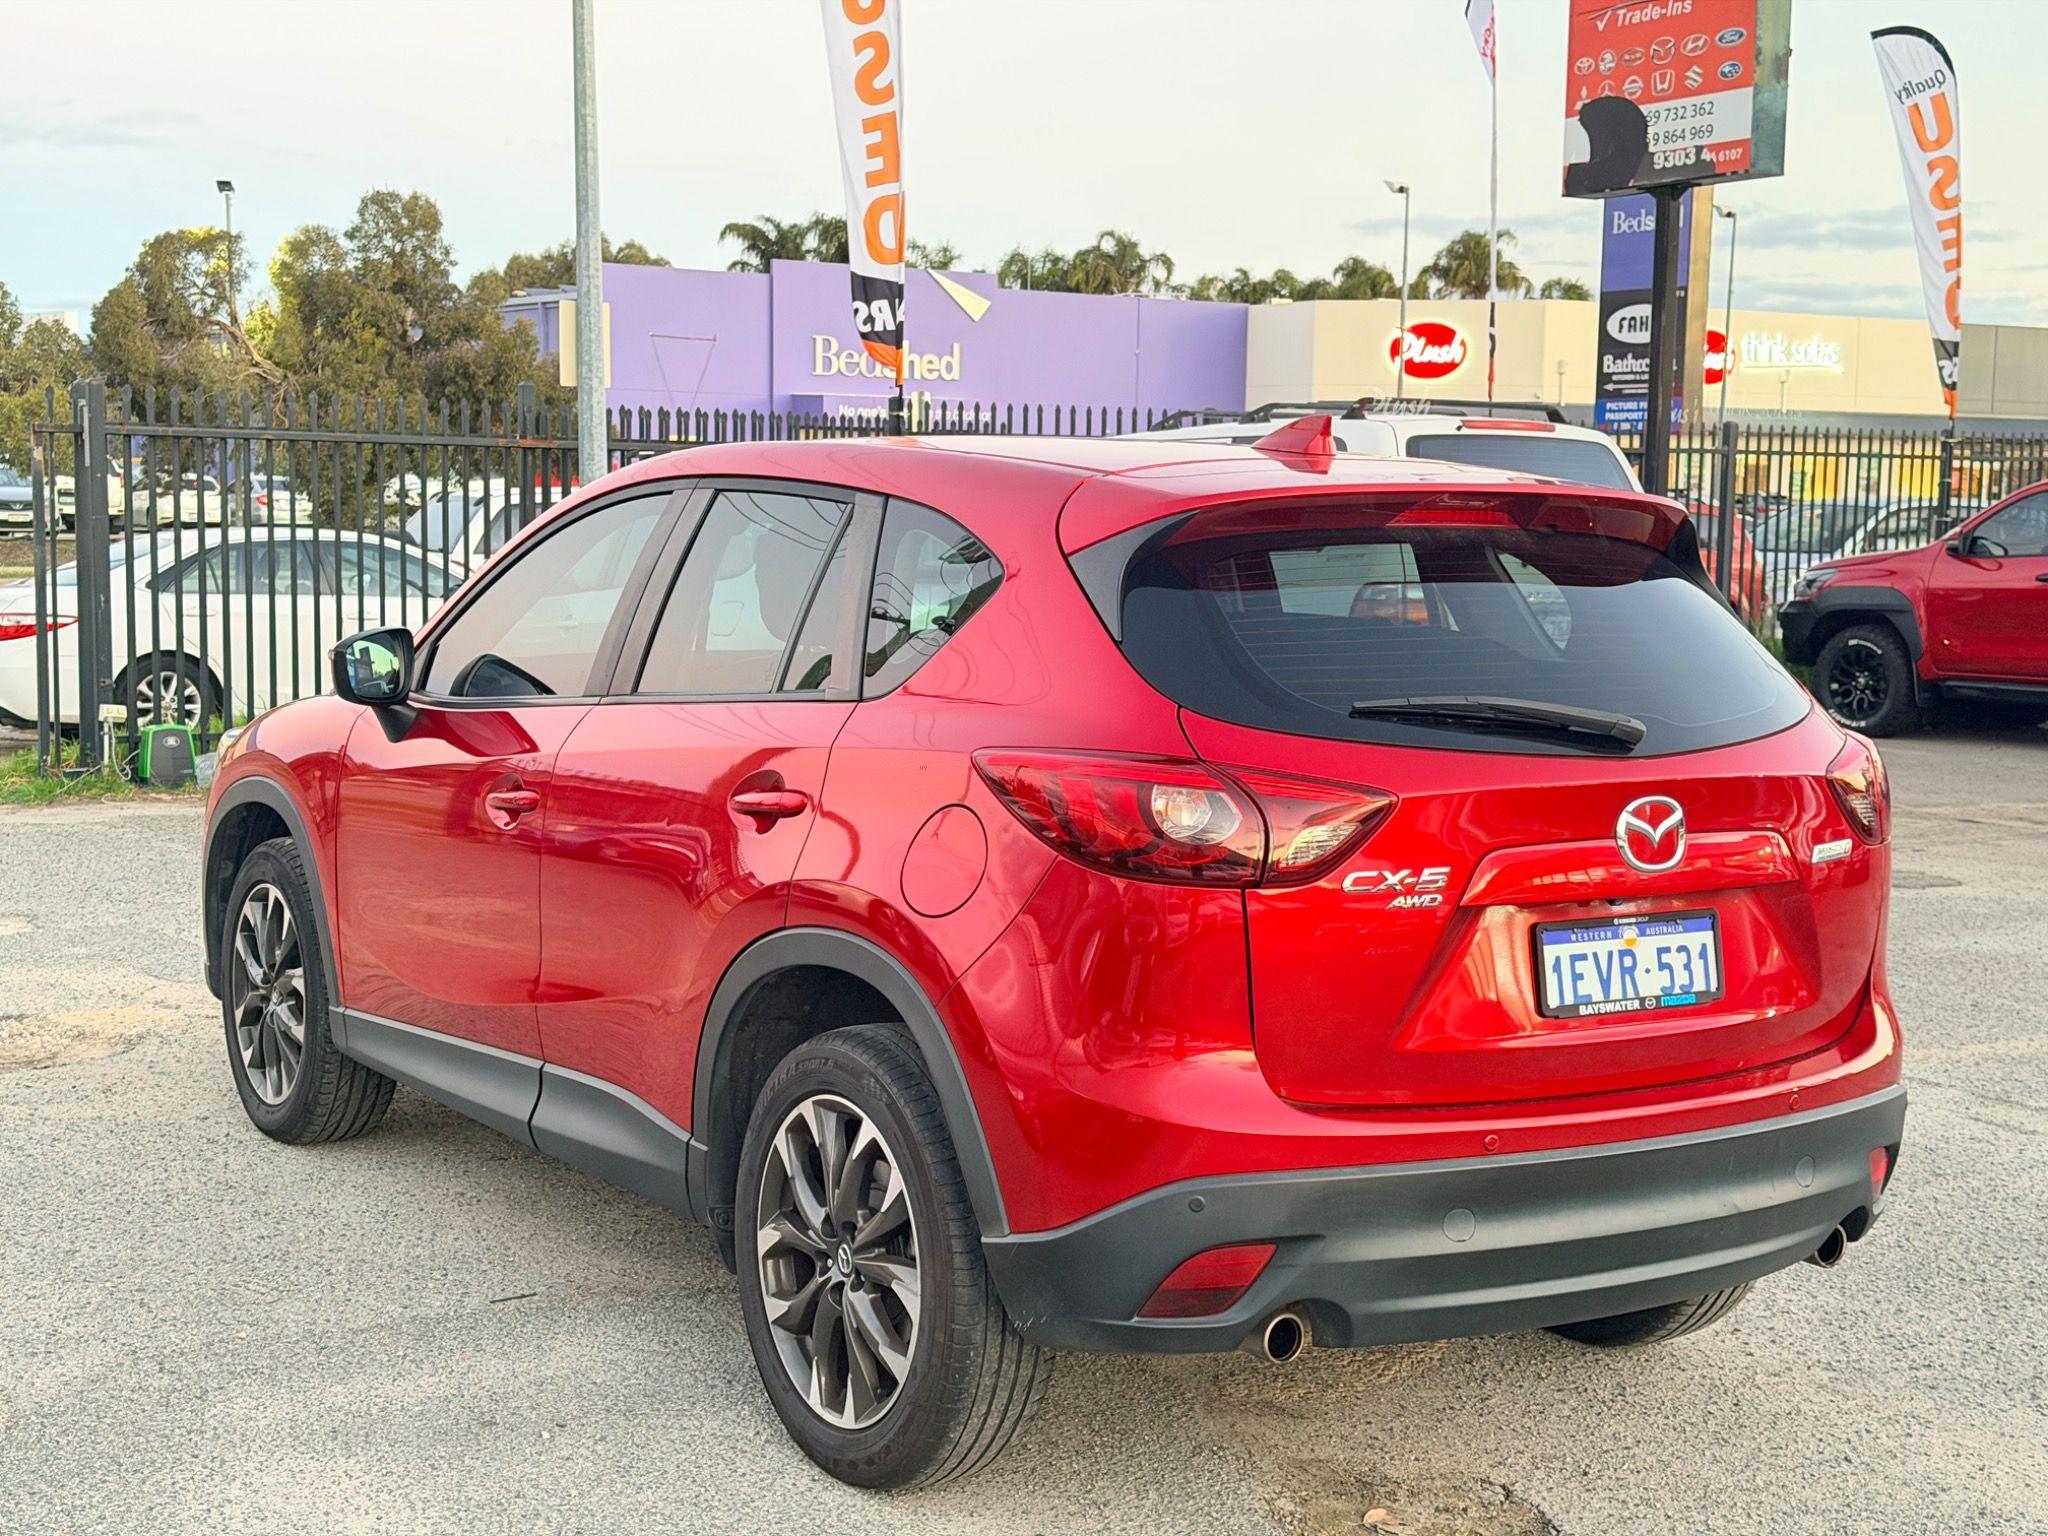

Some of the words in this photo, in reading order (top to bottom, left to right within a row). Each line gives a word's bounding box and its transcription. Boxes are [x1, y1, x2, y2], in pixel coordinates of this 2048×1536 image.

[1616, 0, 1693, 27] Trade-Ins
[1664, 105, 1687, 122] 732
[1690, 101, 1715, 118] 362
[1663, 128, 1686, 144] 864
[1690, 123, 1714, 140] 969
[1653, 147, 1697, 170] 9303
[1718, 147, 1743, 162] 6107
[1618, 315, 1649, 334] FAH
[1341, 866, 1452, 893] CX-5
[1384, 893, 1444, 910] AWD
[1570, 930, 1613, 942] WESTERN
[1645, 924, 1684, 936] AUSTRALIA
[1578, 999, 1641, 1016] BAYSWATER
